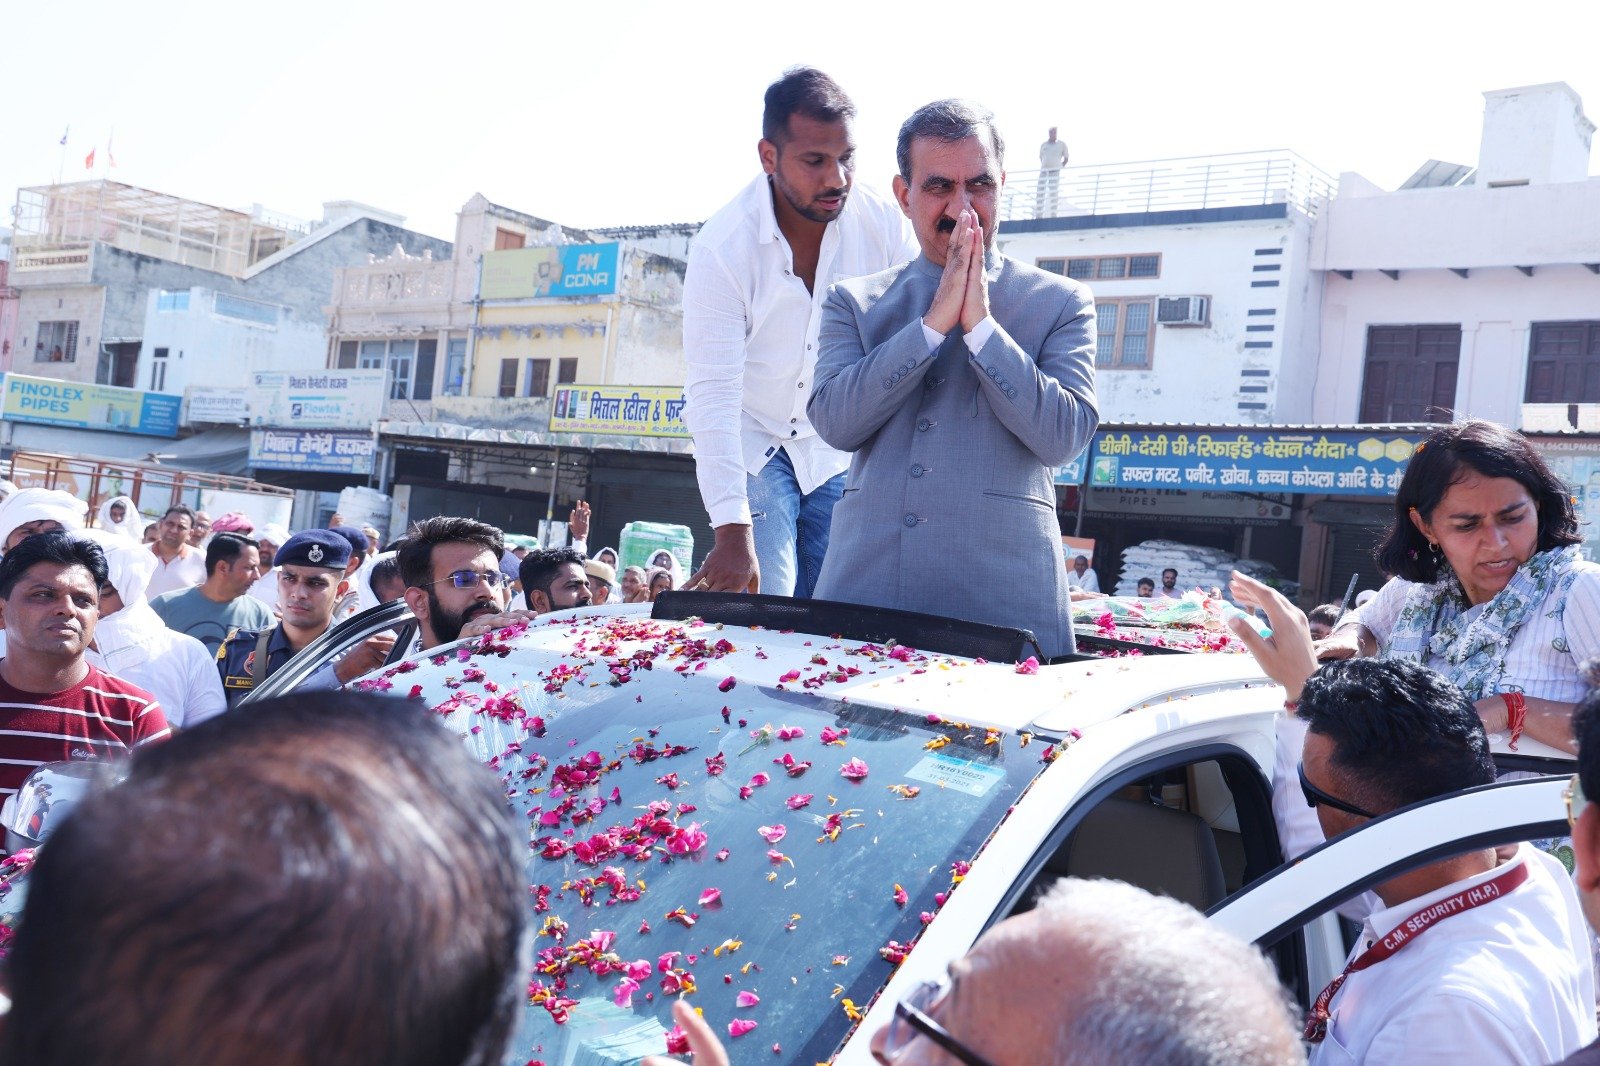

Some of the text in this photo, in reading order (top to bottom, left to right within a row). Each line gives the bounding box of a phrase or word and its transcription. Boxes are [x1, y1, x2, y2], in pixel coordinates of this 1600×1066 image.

[577, 253, 600, 272] PM
[565, 272, 609, 288] CONA
[10, 380, 85, 401] FINOLEX
[20, 396, 71, 413] PIPES
[589, 391, 622, 421] मित्तल
[623, 391, 651, 422] स्टील
[652, 400, 661, 422] &
[1099, 433, 1131, 456] चीनी
[1139, 434, 1169, 456] देसी
[1171, 434, 1188, 456] घी
[1262, 435, 1304, 459] बेसन
[1313, 435, 1347, 459] मैदा
[1122, 466, 1153, 483] सफल
[1292, 465, 1335, 488] कोयला
[1336, 465, 1368, 489] आदि
[1370, 467, 1385, 489] के
[1119, 496, 1158, 506] PIPES
[1383, 882, 1500, 951] C.M. SECURITY (H.P.)
